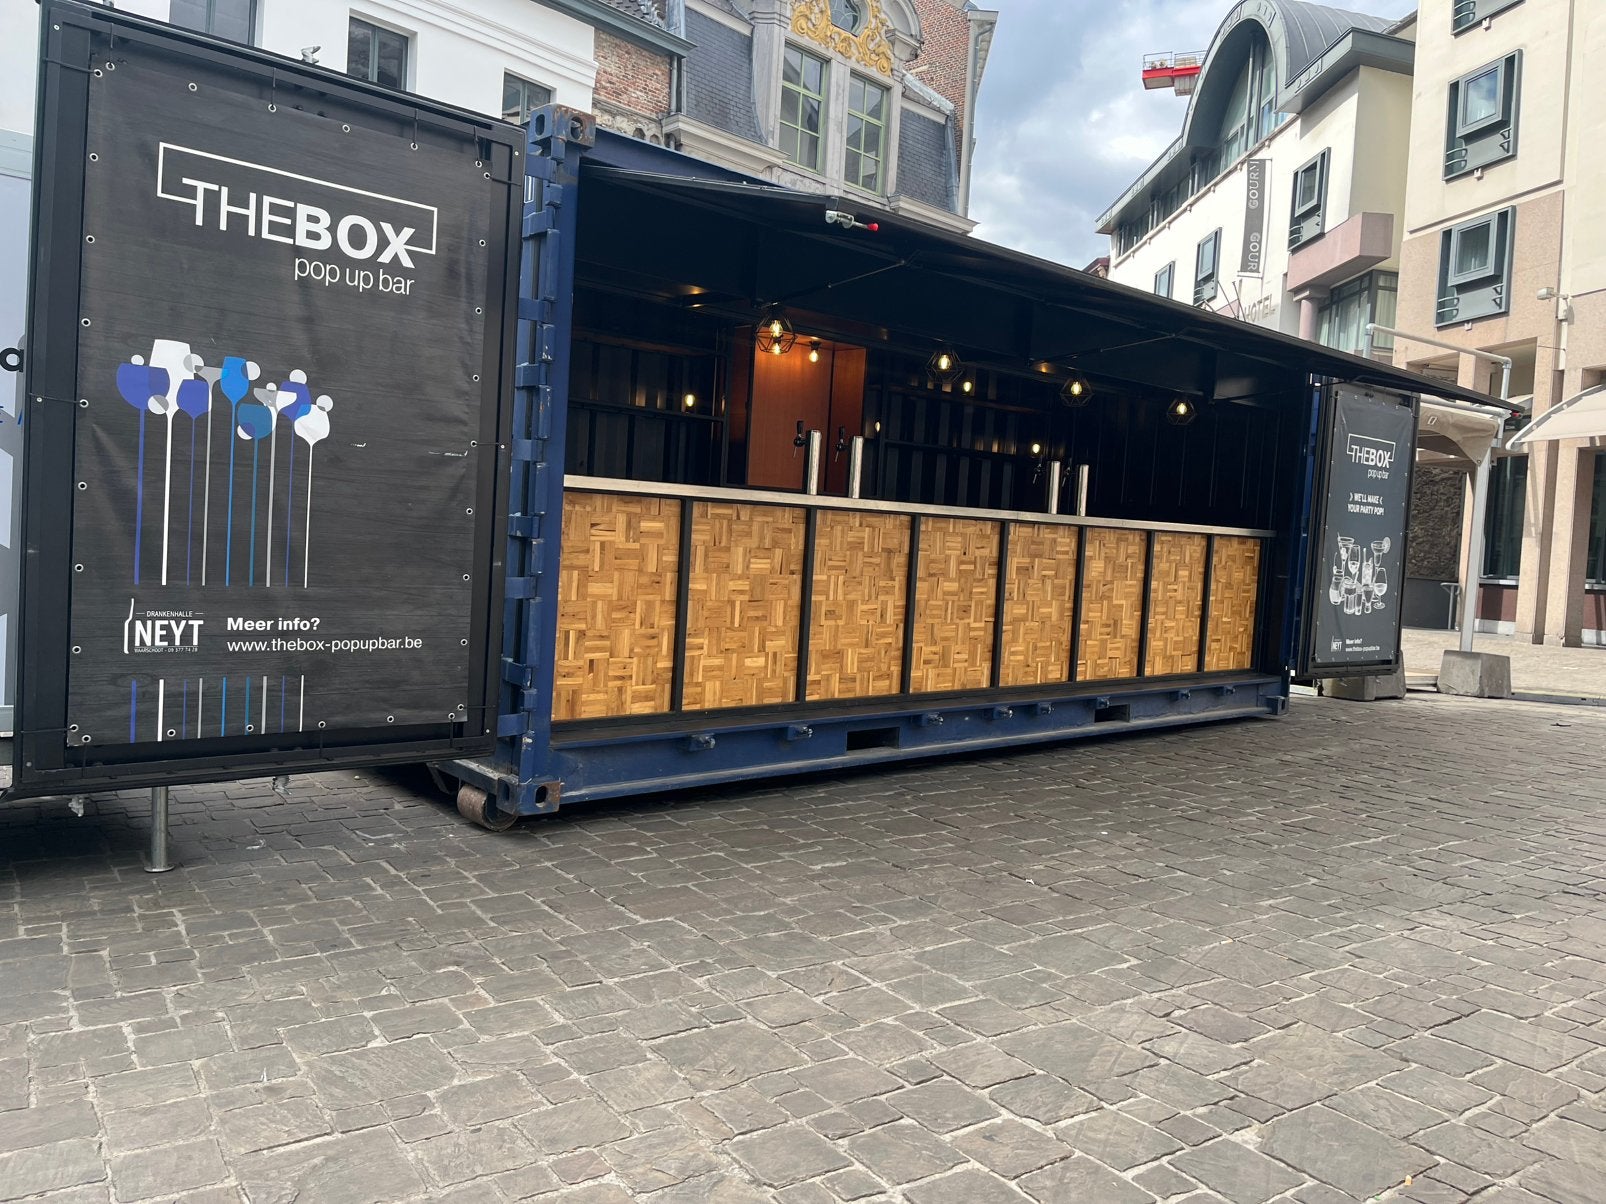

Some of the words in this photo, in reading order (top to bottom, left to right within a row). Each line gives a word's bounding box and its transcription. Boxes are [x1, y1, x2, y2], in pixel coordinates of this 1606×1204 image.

[182, 177, 415, 268] THEBOX
[294, 257, 340, 286] pop
[345, 270, 373, 292] up
[379, 268, 415, 295] bar
[1351, 445, 1391, 468] THEBOX
[1367, 494, 1380, 504] MAKE
[1347, 503, 1360, 513] YOUR
[1360, 505, 1374, 514] PARTY
[1374, 506, 1384, 516] POP!
[146, 610, 193, 618] DRANKENHALLE
[227, 617, 274, 631] Meer
[278, 617, 320, 631] info?
[134, 620, 204, 647] NEYT
[227, 636, 423, 652] www.thebox-popupbar.be
